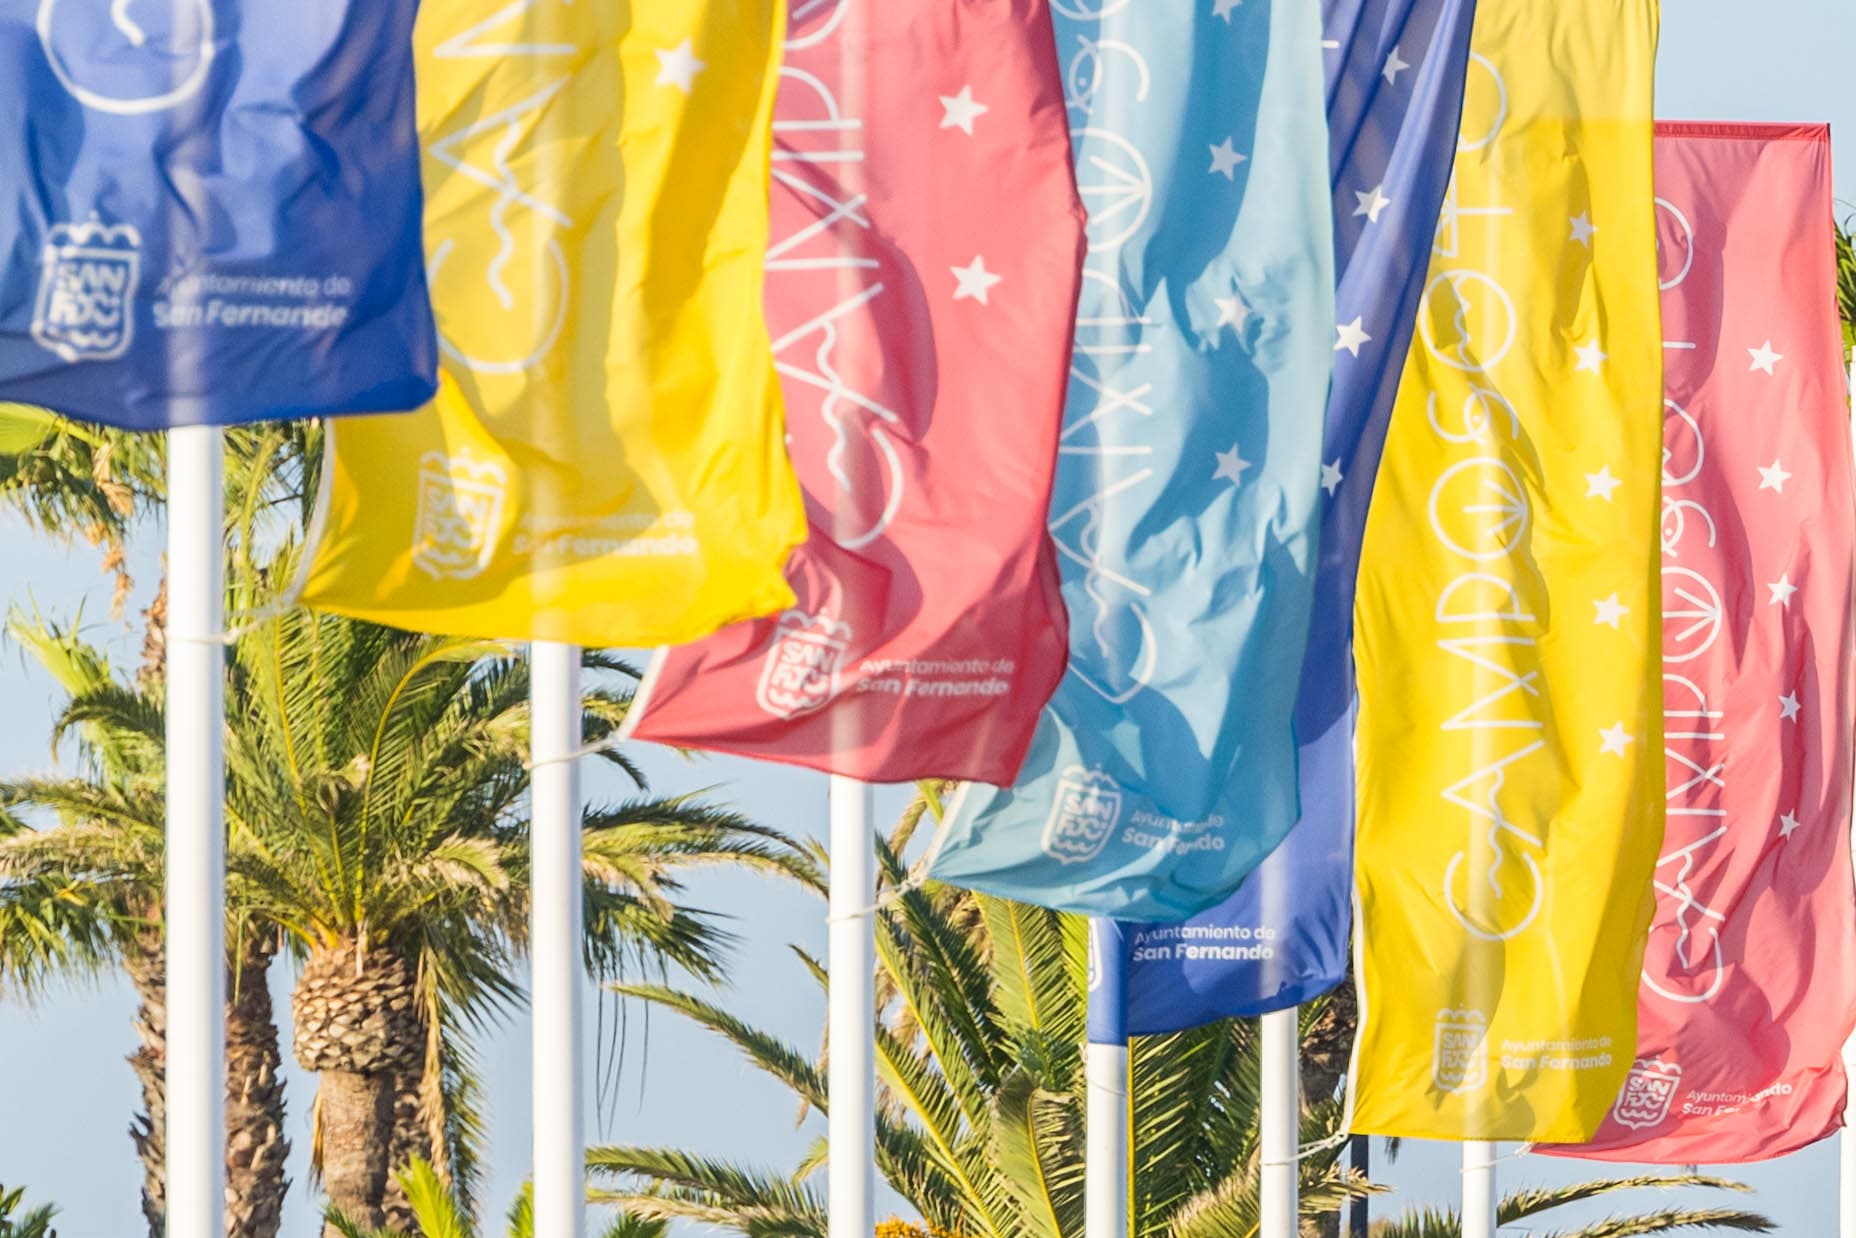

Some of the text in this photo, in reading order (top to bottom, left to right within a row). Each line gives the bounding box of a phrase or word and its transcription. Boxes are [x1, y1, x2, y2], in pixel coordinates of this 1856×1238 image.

[154, 274, 320, 297] Antamiento
[856, 677, 1010, 697] San Fernando
[1134, 924, 1276, 945] Ayuntamiento de
[1132, 943, 1275, 961] San Fernando
